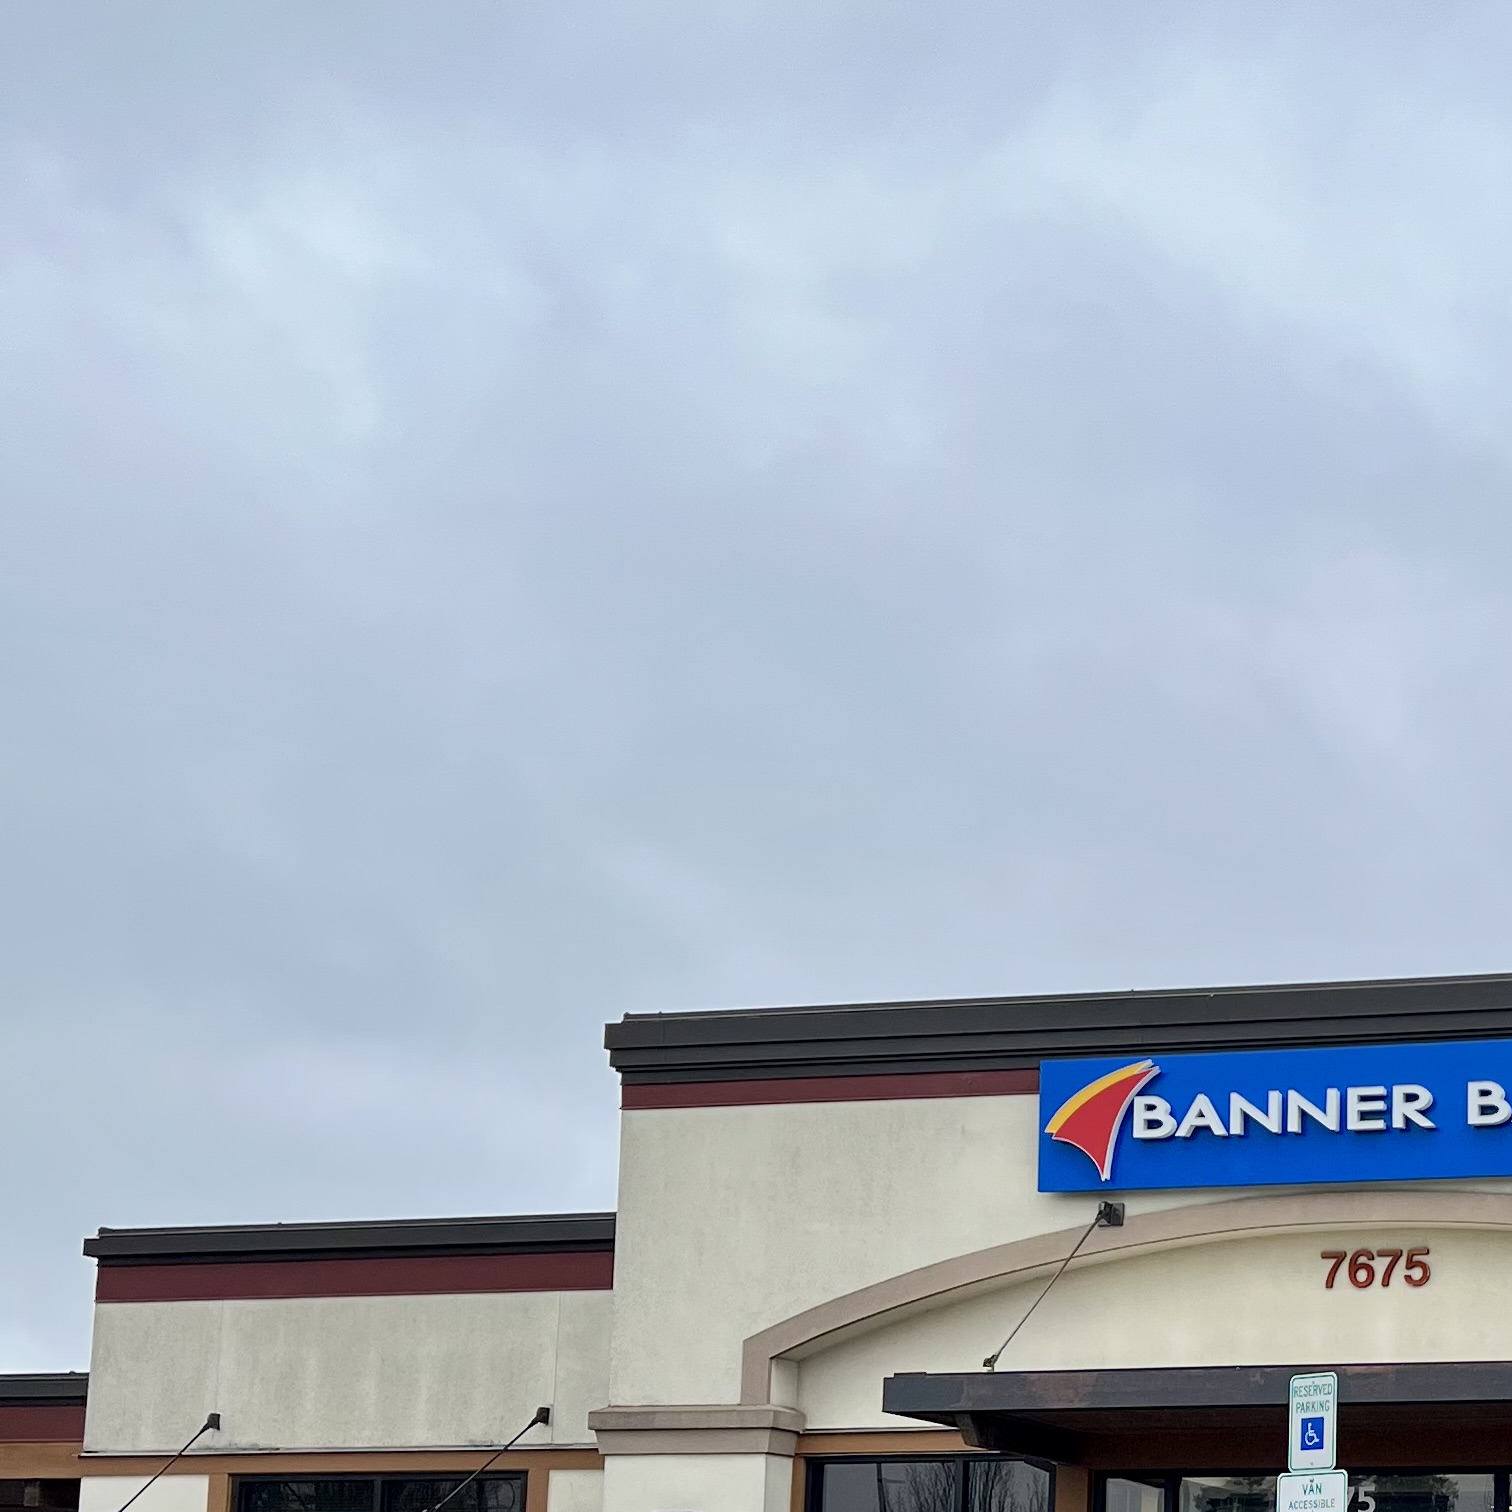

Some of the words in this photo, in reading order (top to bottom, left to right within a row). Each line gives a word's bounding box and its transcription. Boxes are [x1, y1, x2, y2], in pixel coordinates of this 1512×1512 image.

[1132, 1083, 1437, 1140] BANNER
[1321, 1248, 1430, 1288] 7675
[1293, 1383, 1333, 1398] RESERVED
[1295, 1400, 1331, 1414] PARKING
[1302, 1483, 1322, 1495] VAN
[1288, 1498, 1335, 1510] ACCESSIBLE
